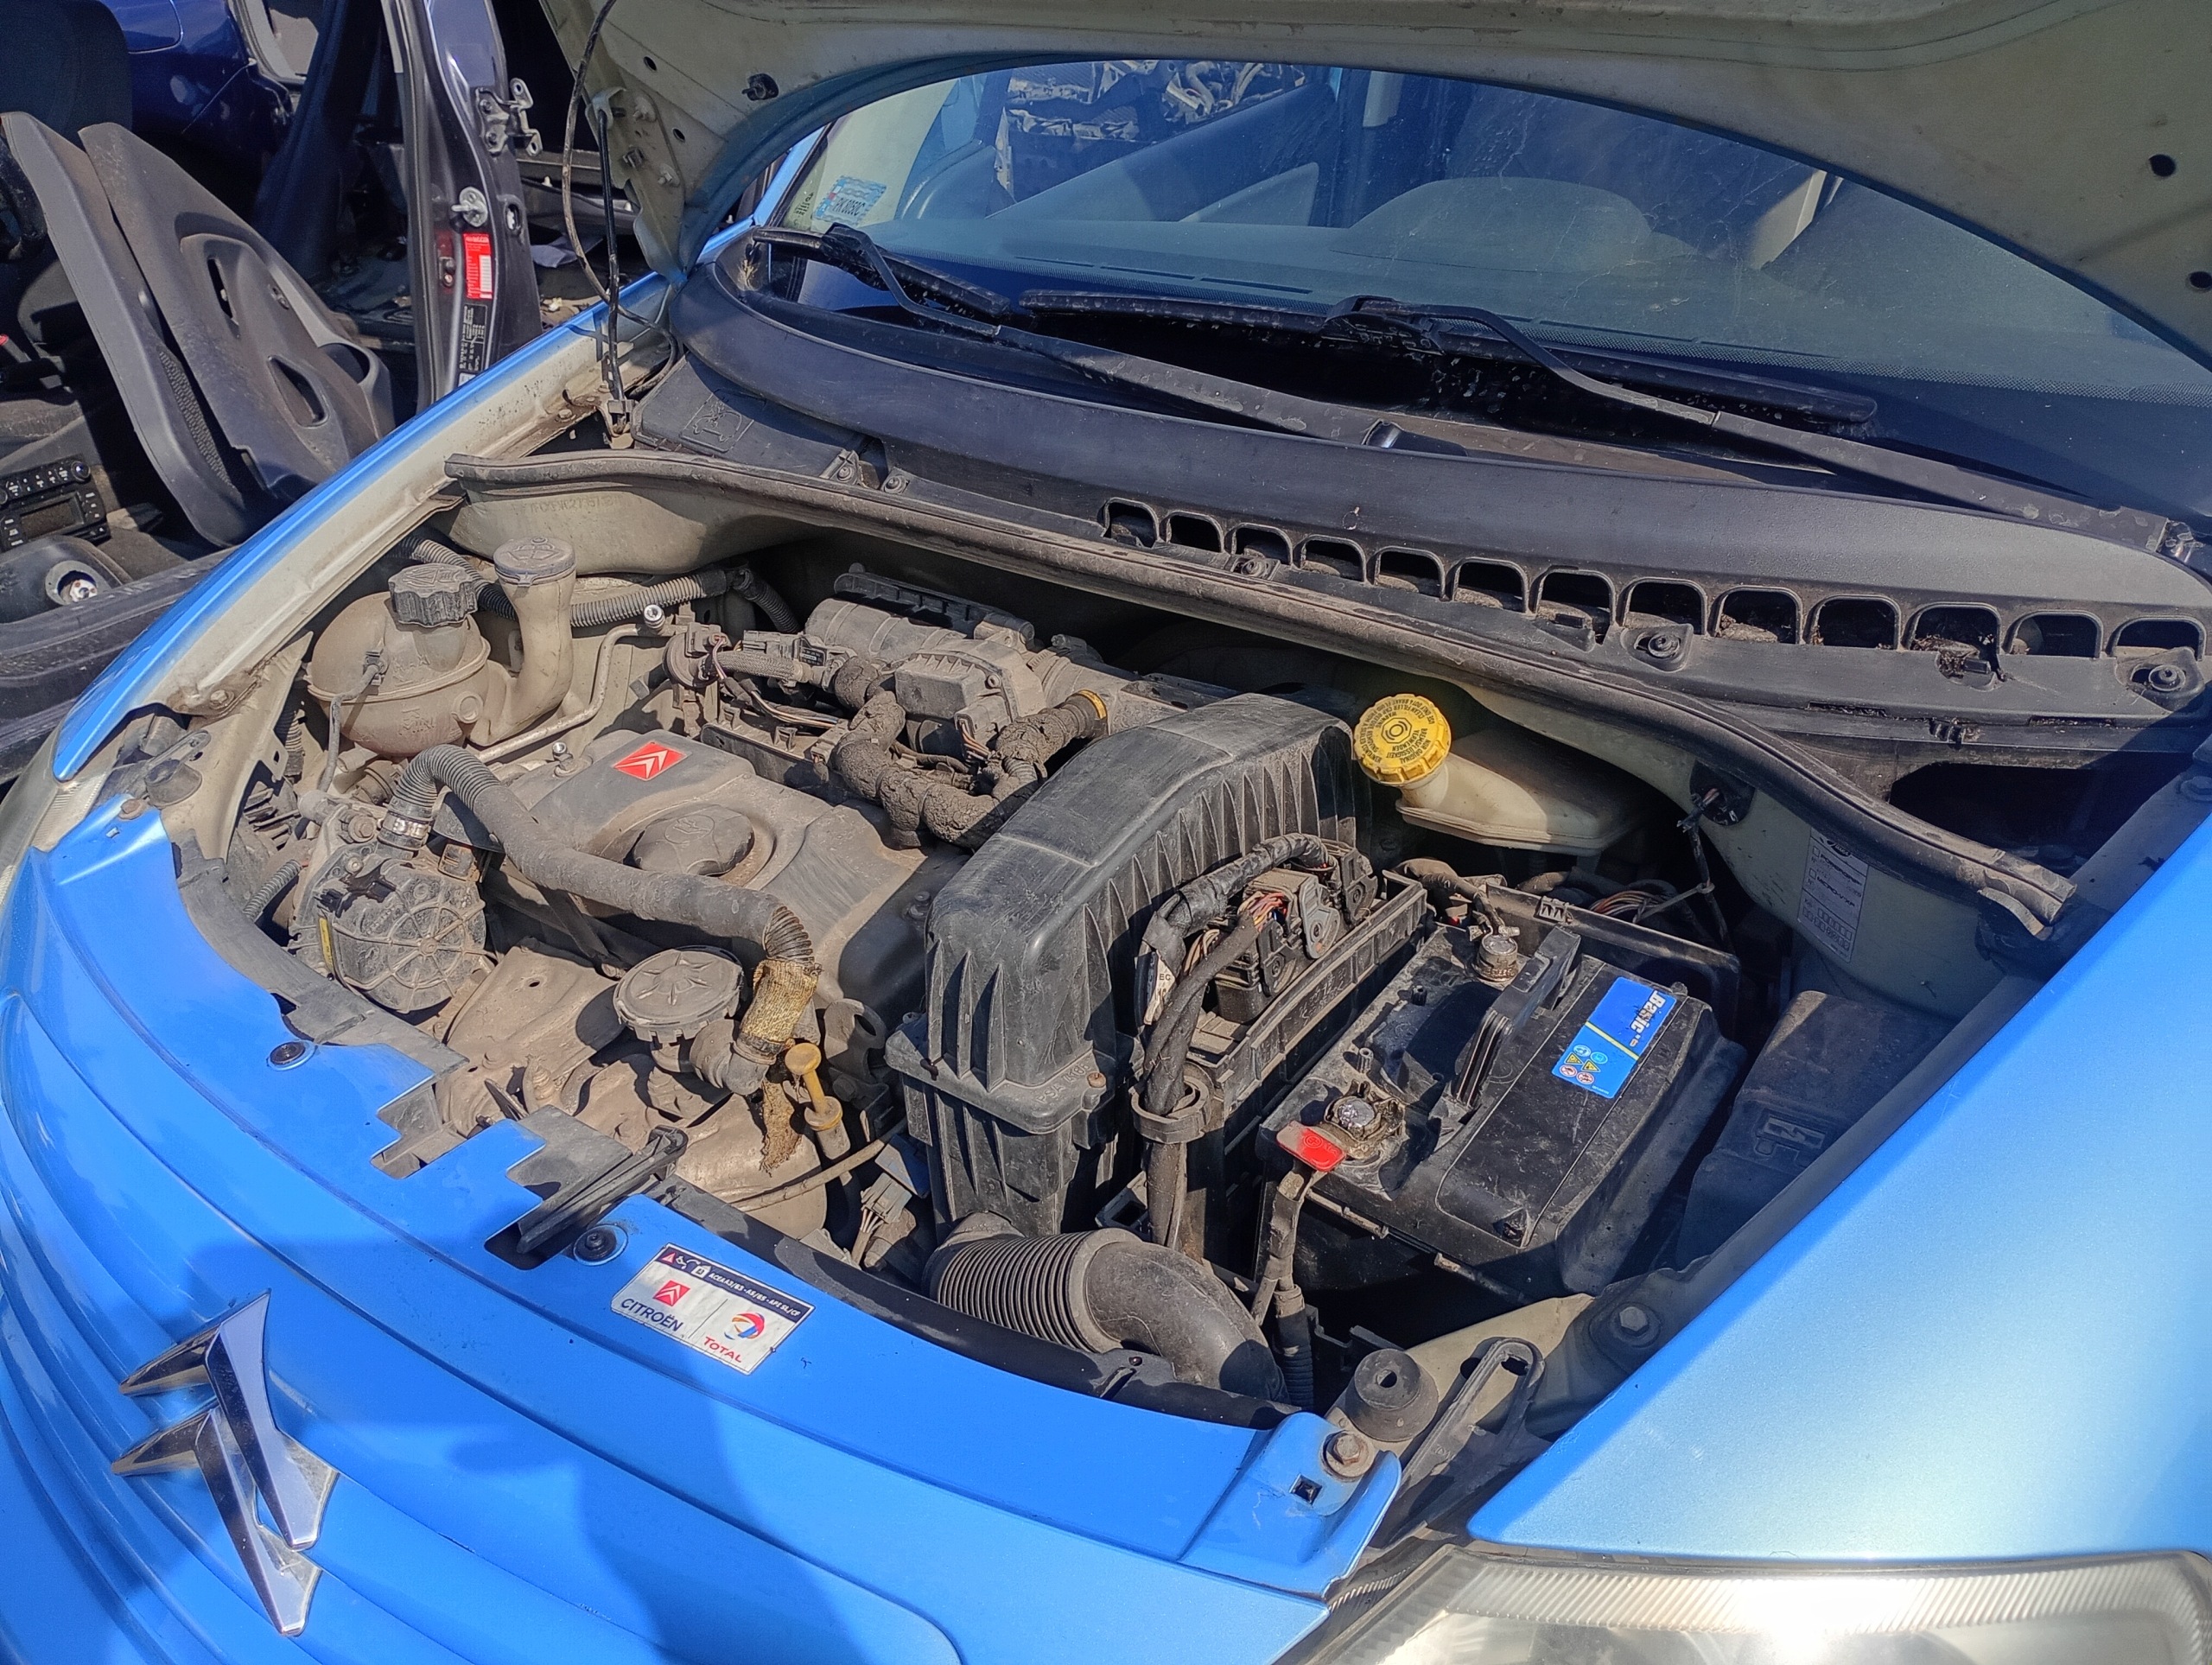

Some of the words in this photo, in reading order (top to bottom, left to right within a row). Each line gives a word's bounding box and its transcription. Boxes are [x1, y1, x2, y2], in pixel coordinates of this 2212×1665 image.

[1630, 990, 1666, 1033] Basic
[620, 1298, 684, 1331] CITROËN
[702, 1336, 743, 1363] TOTAL
